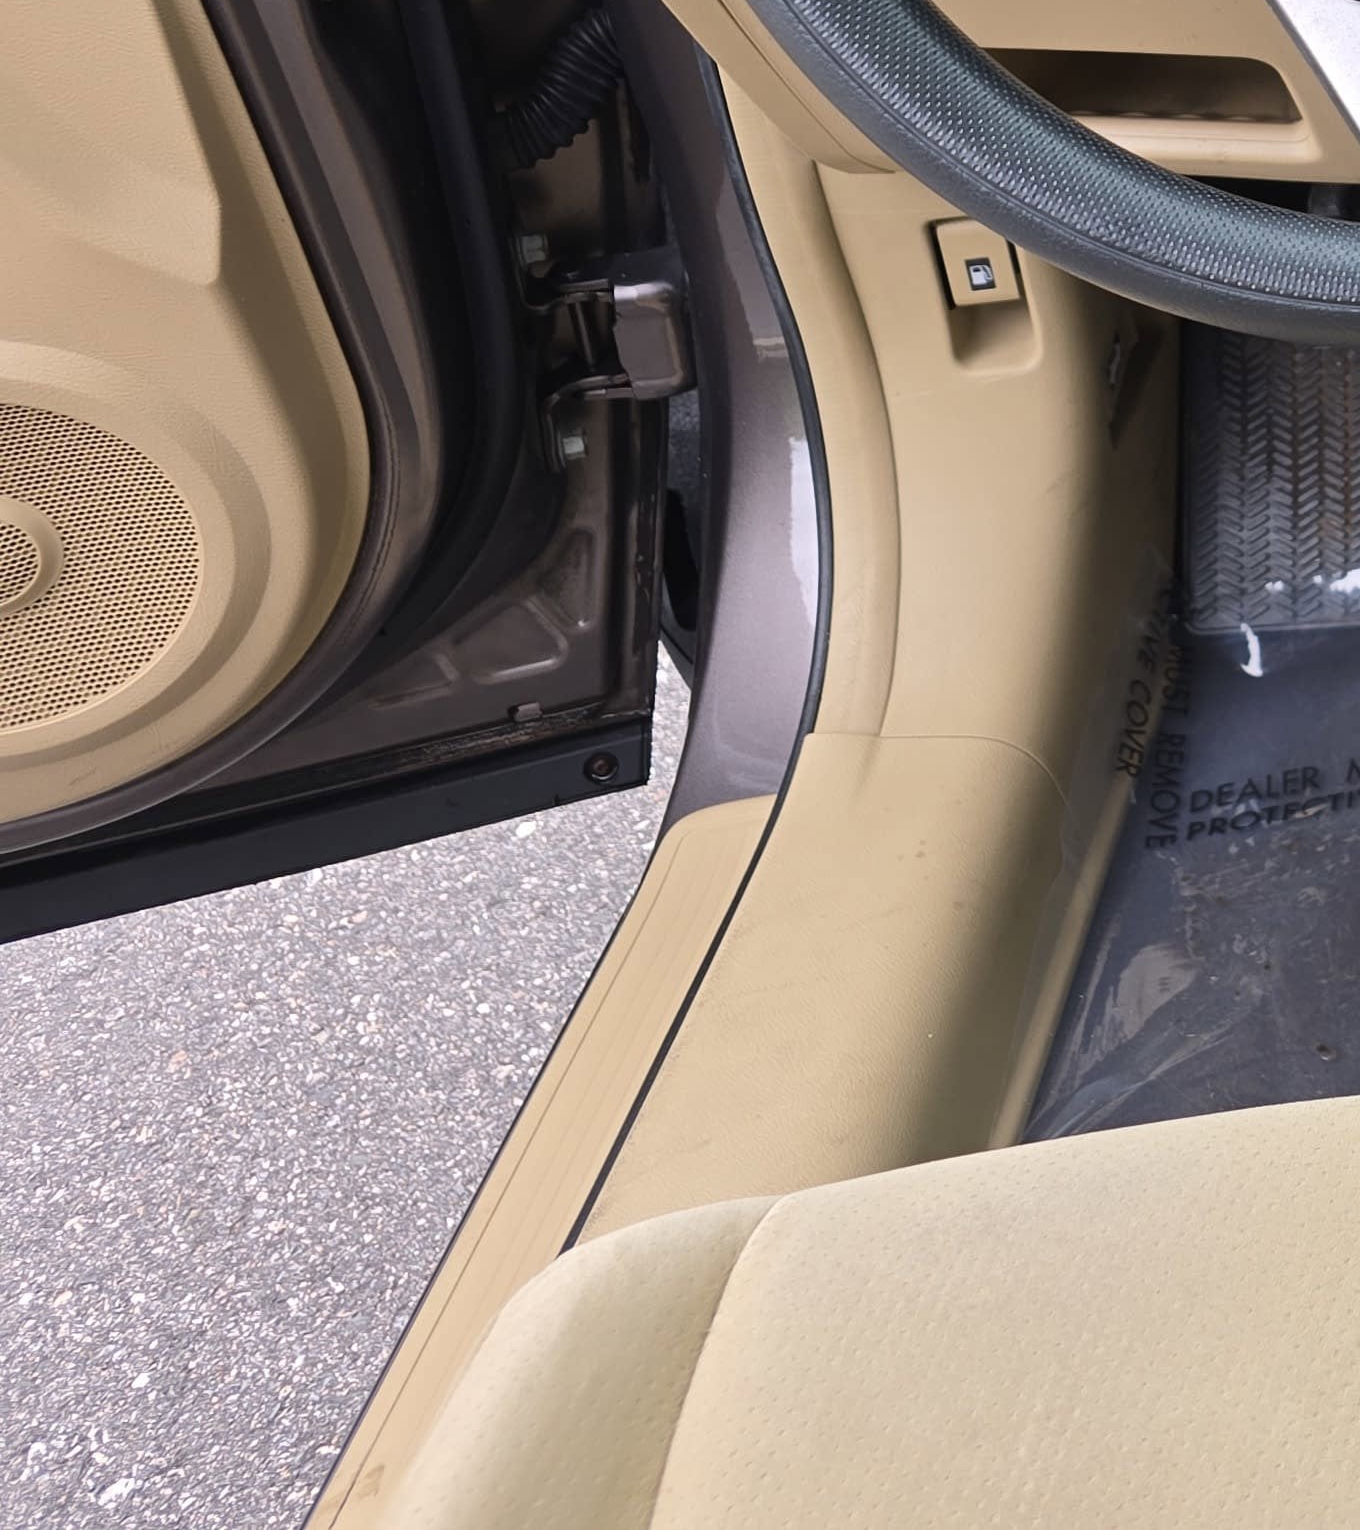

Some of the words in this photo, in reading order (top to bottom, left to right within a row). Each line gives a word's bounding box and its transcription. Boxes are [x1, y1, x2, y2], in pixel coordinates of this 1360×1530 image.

[1116, 679, 1152, 779] COVER
[1146, 732, 1188, 849] REMOVE
[1188, 767, 1320, 815] DEALER
